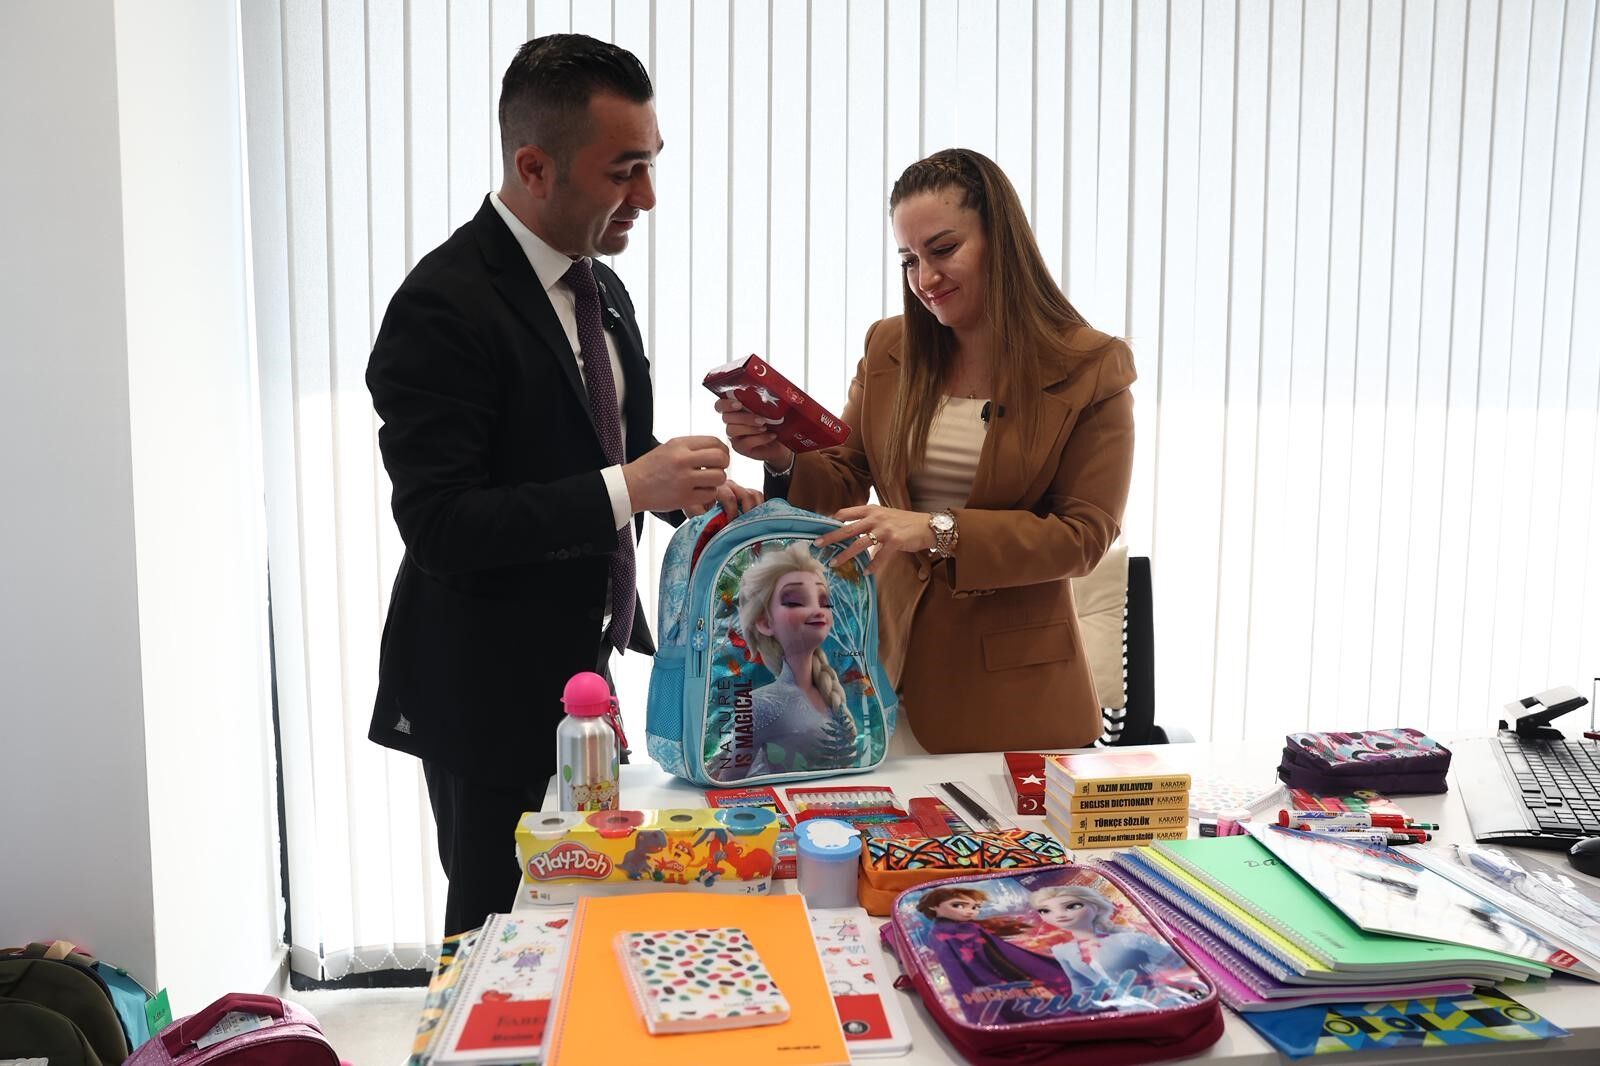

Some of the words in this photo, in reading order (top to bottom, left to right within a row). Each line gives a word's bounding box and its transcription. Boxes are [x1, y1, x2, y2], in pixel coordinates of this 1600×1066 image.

[734, 680, 753, 749] MAGICAL
[717, 678, 731, 769] NATURE
[735, 750, 753, 768] IS
[1097, 783, 1118, 793] YAZIM
[1120, 782, 1153, 792] KILAVUZU
[1160, 780, 1187, 788] KARATAY
[1080, 800, 1110, 809] ENGLISH
[1111, 797, 1155, 808] DICTIONARY
[1157, 795, 1184, 803] KARATAY
[1094, 817, 1122, 828] TÜRKÇE
[1123, 816, 1150, 827] SÖZLÜK
[1158, 815, 1185, 823] KARATAY
[1156, 831, 1183, 839] KARATAY
[530, 849, 608, 876] Play-Doh
